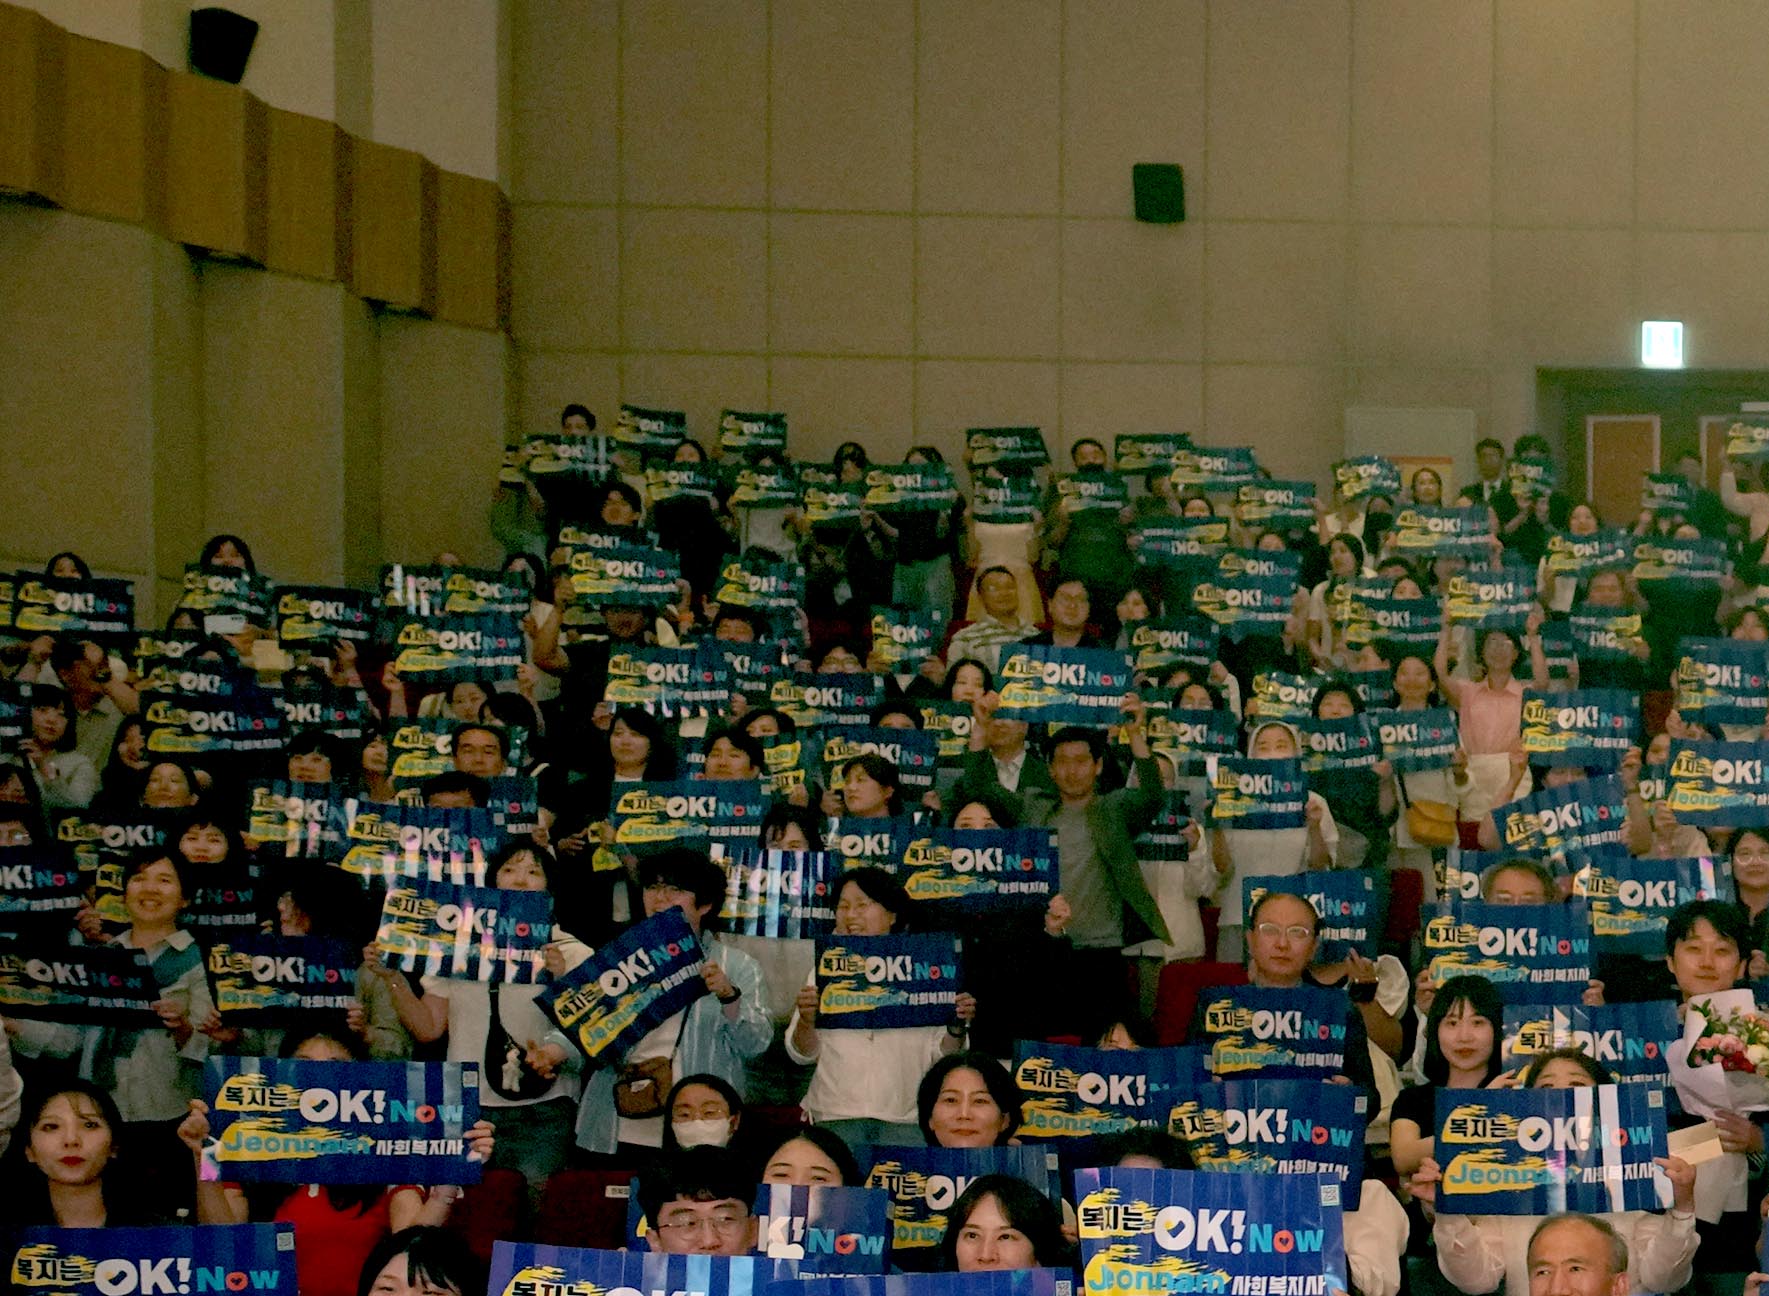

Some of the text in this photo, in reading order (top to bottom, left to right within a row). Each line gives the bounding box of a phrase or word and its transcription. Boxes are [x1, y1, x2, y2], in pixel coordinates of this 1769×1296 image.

[436, 631, 481, 650] OK!
[644, 662, 689, 683] OK!
[1040, 662, 1086, 686] OK!
[950, 848, 1003, 872] OK!
[435, 902, 497, 936] OK!
[1476, 927, 1537, 956] OK!
[1539, 933, 1589, 956] Now
[225, 1085, 463, 1124] 복지는 OK! Now
[221, 1131, 466, 1157] Jeonnam 사회복지사
[1080, 1205, 1324, 1254] 복지는 OK! Now
[14, 1256, 279, 1296] 복지는 OK! Now
[1232, 1274, 1327, 1296] 사회복지사
